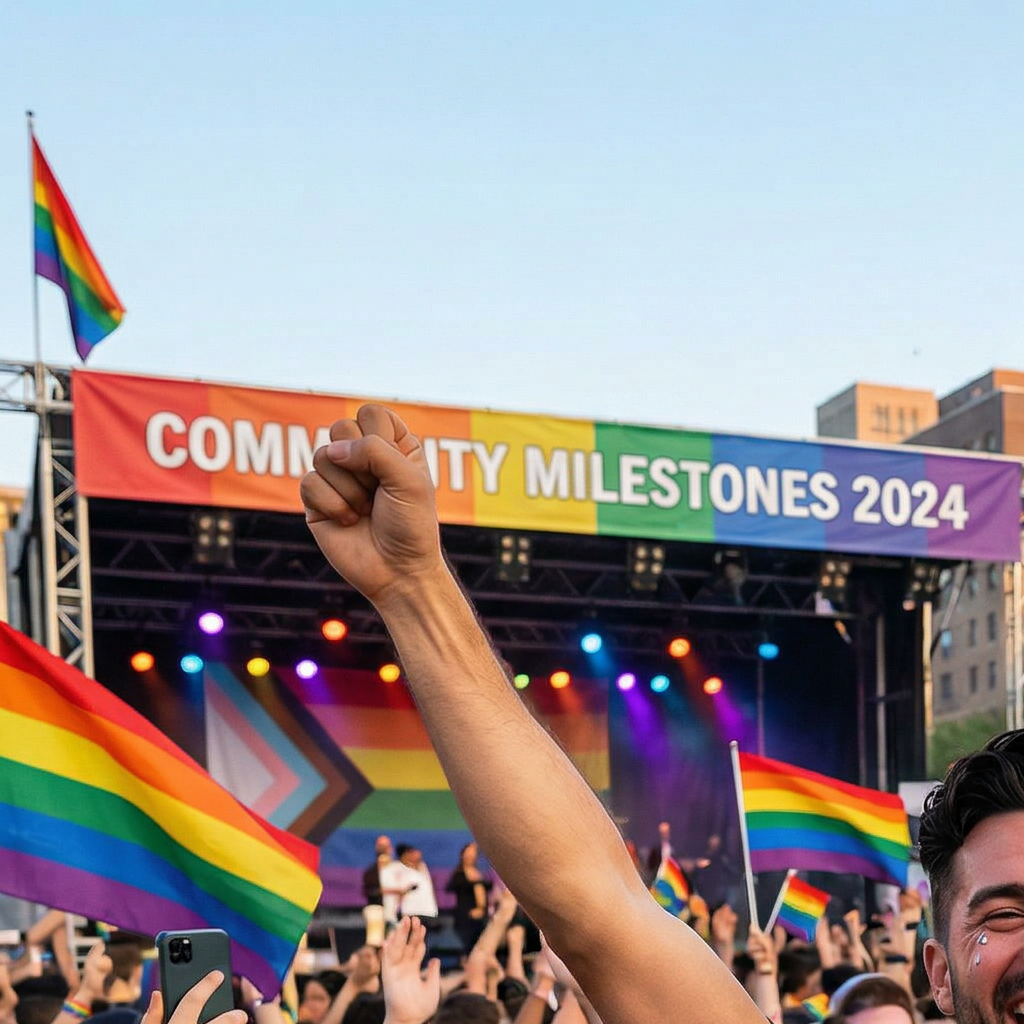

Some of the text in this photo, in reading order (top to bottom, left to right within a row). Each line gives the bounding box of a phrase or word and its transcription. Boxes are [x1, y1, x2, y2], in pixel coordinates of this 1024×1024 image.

[146, 411, 969, 531] COMMITY MILESTONES 2024
